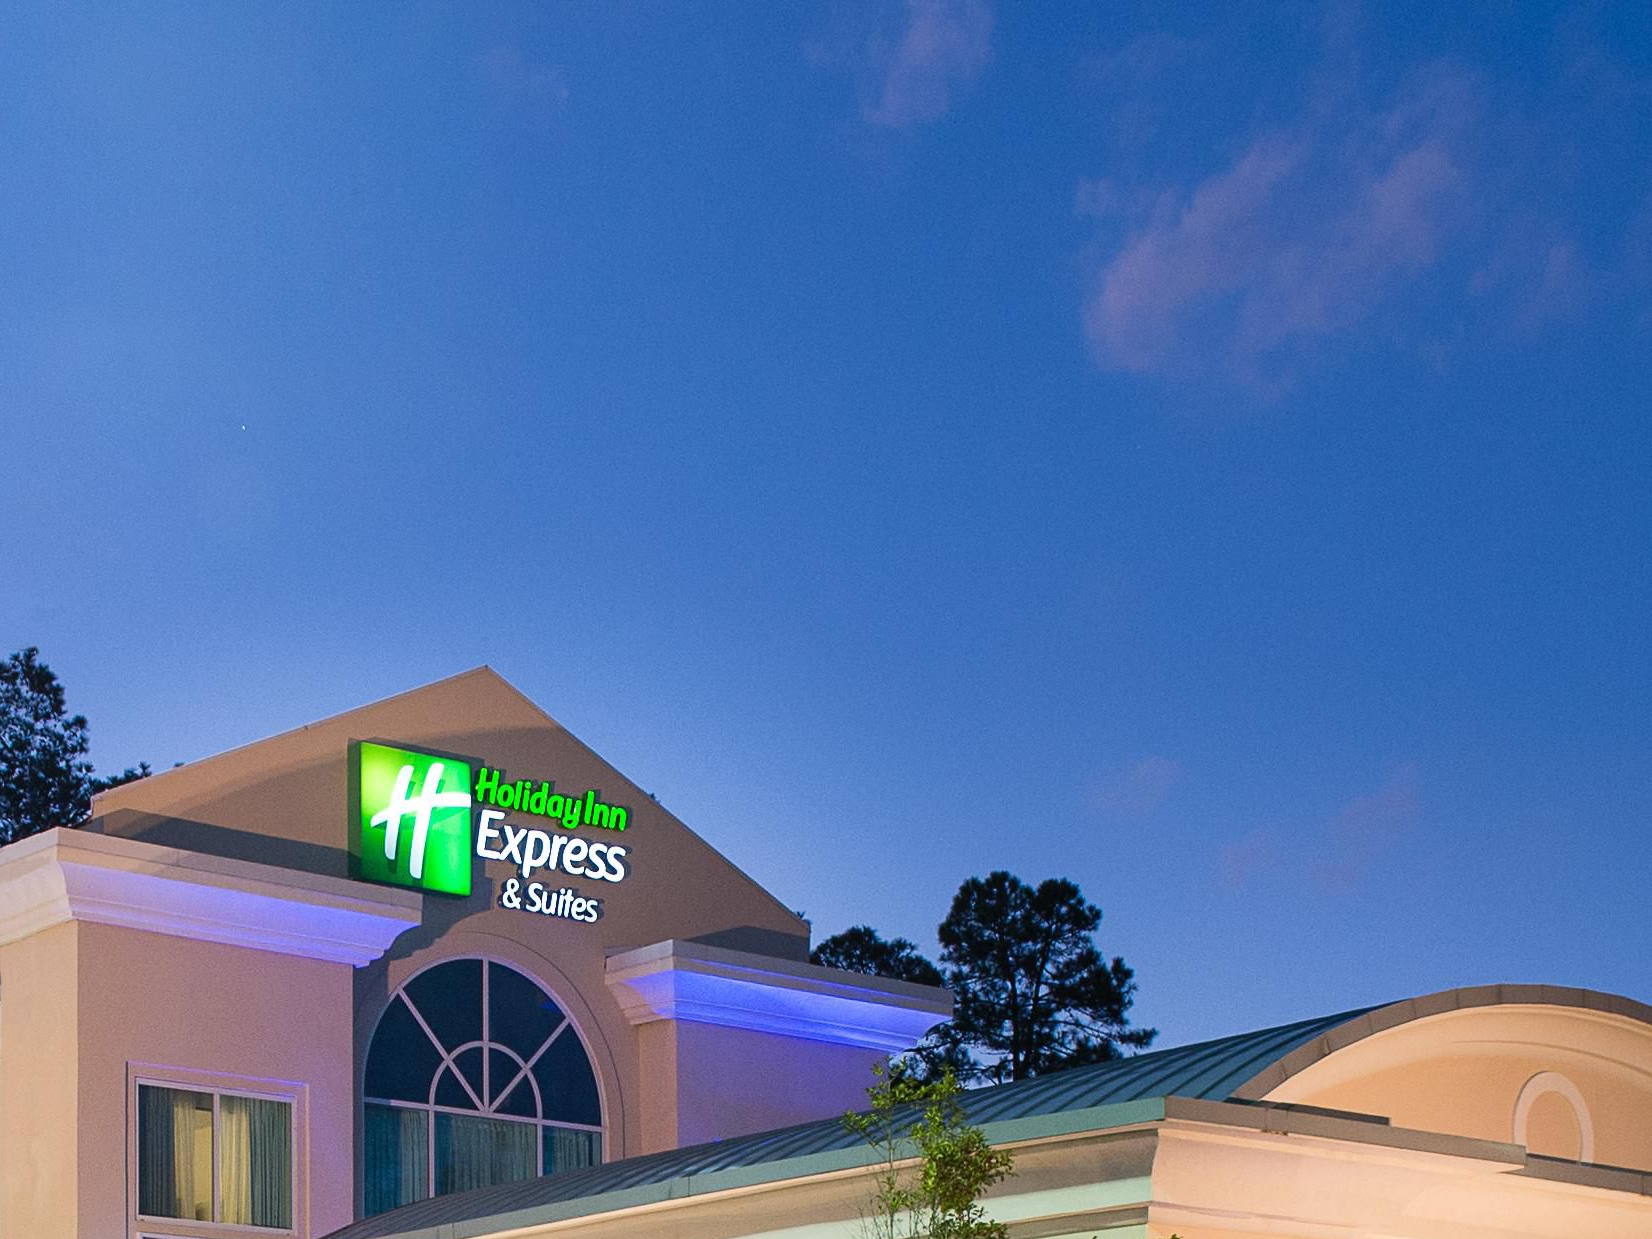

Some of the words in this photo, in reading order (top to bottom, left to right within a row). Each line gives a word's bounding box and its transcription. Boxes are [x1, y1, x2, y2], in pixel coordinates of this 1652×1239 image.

[370, 763, 471, 879] H
[475, 768, 580, 829] Holiday
[584, 790, 627, 831] Inn
[476, 809, 625, 882] Express
[502, 878, 521, 909] &
[526, 883, 598, 923] Suites
